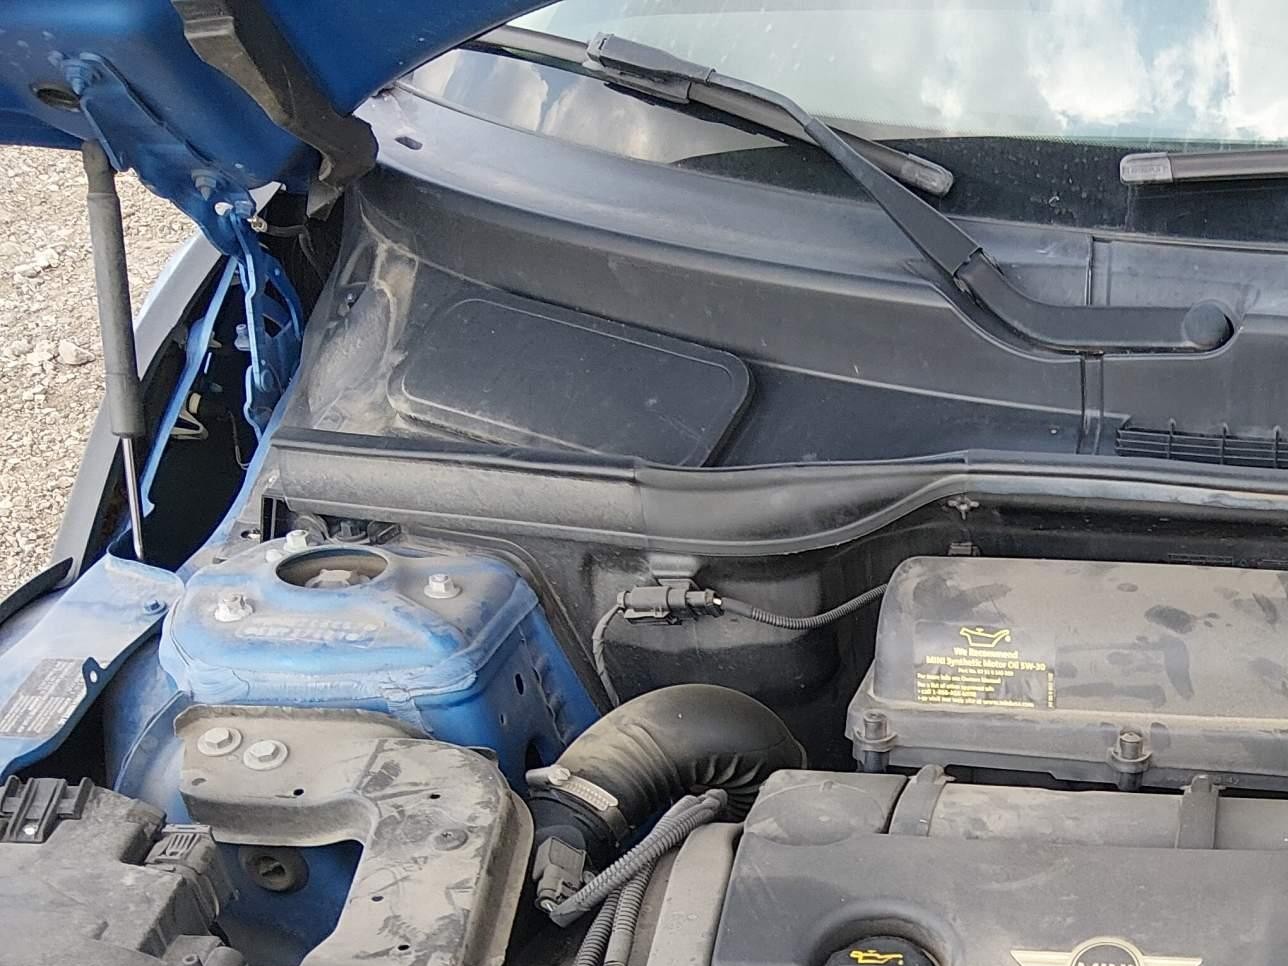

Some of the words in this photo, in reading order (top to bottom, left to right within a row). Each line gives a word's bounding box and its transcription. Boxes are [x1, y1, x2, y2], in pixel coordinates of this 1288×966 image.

[968, 648, 1018, 659] Recommend
[926, 655, 946, 665] MINI
[947, 656, 982, 668] Synthetic
[982, 659, 1007, 669] Motor
[1007, 660, 1019, 669] Oil
[1020, 661, 1046, 671] 5W-30
